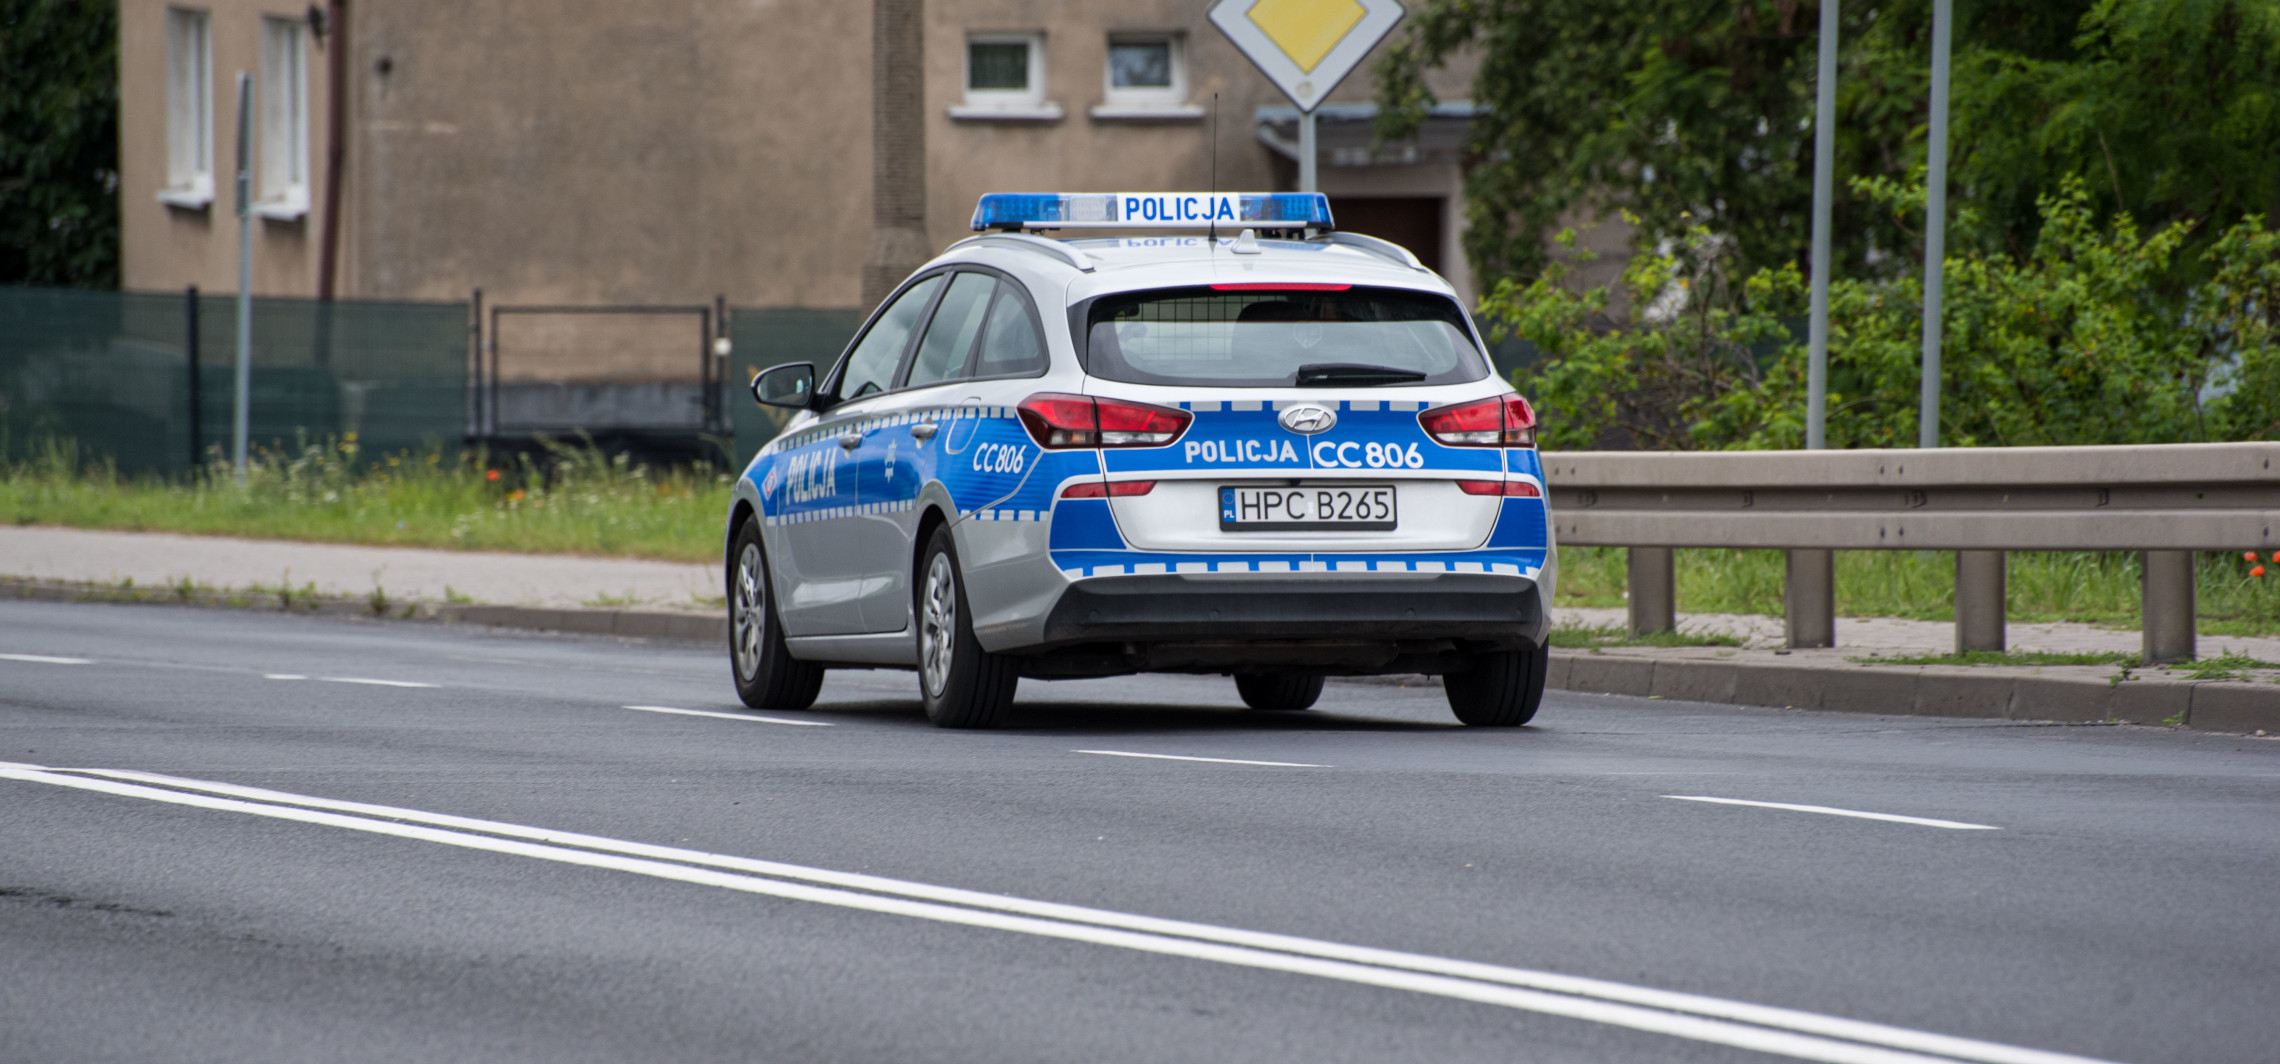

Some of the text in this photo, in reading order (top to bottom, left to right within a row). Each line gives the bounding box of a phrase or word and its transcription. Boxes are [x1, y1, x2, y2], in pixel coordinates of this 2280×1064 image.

[1125, 197, 1235, 221] POLICJA
[1184, 440, 1299, 463] POLICJA
[786, 447, 837, 505] POLICJA
[1223, 510, 1235, 519] PL
[1241, 491, 1389, 520] HPC B265
